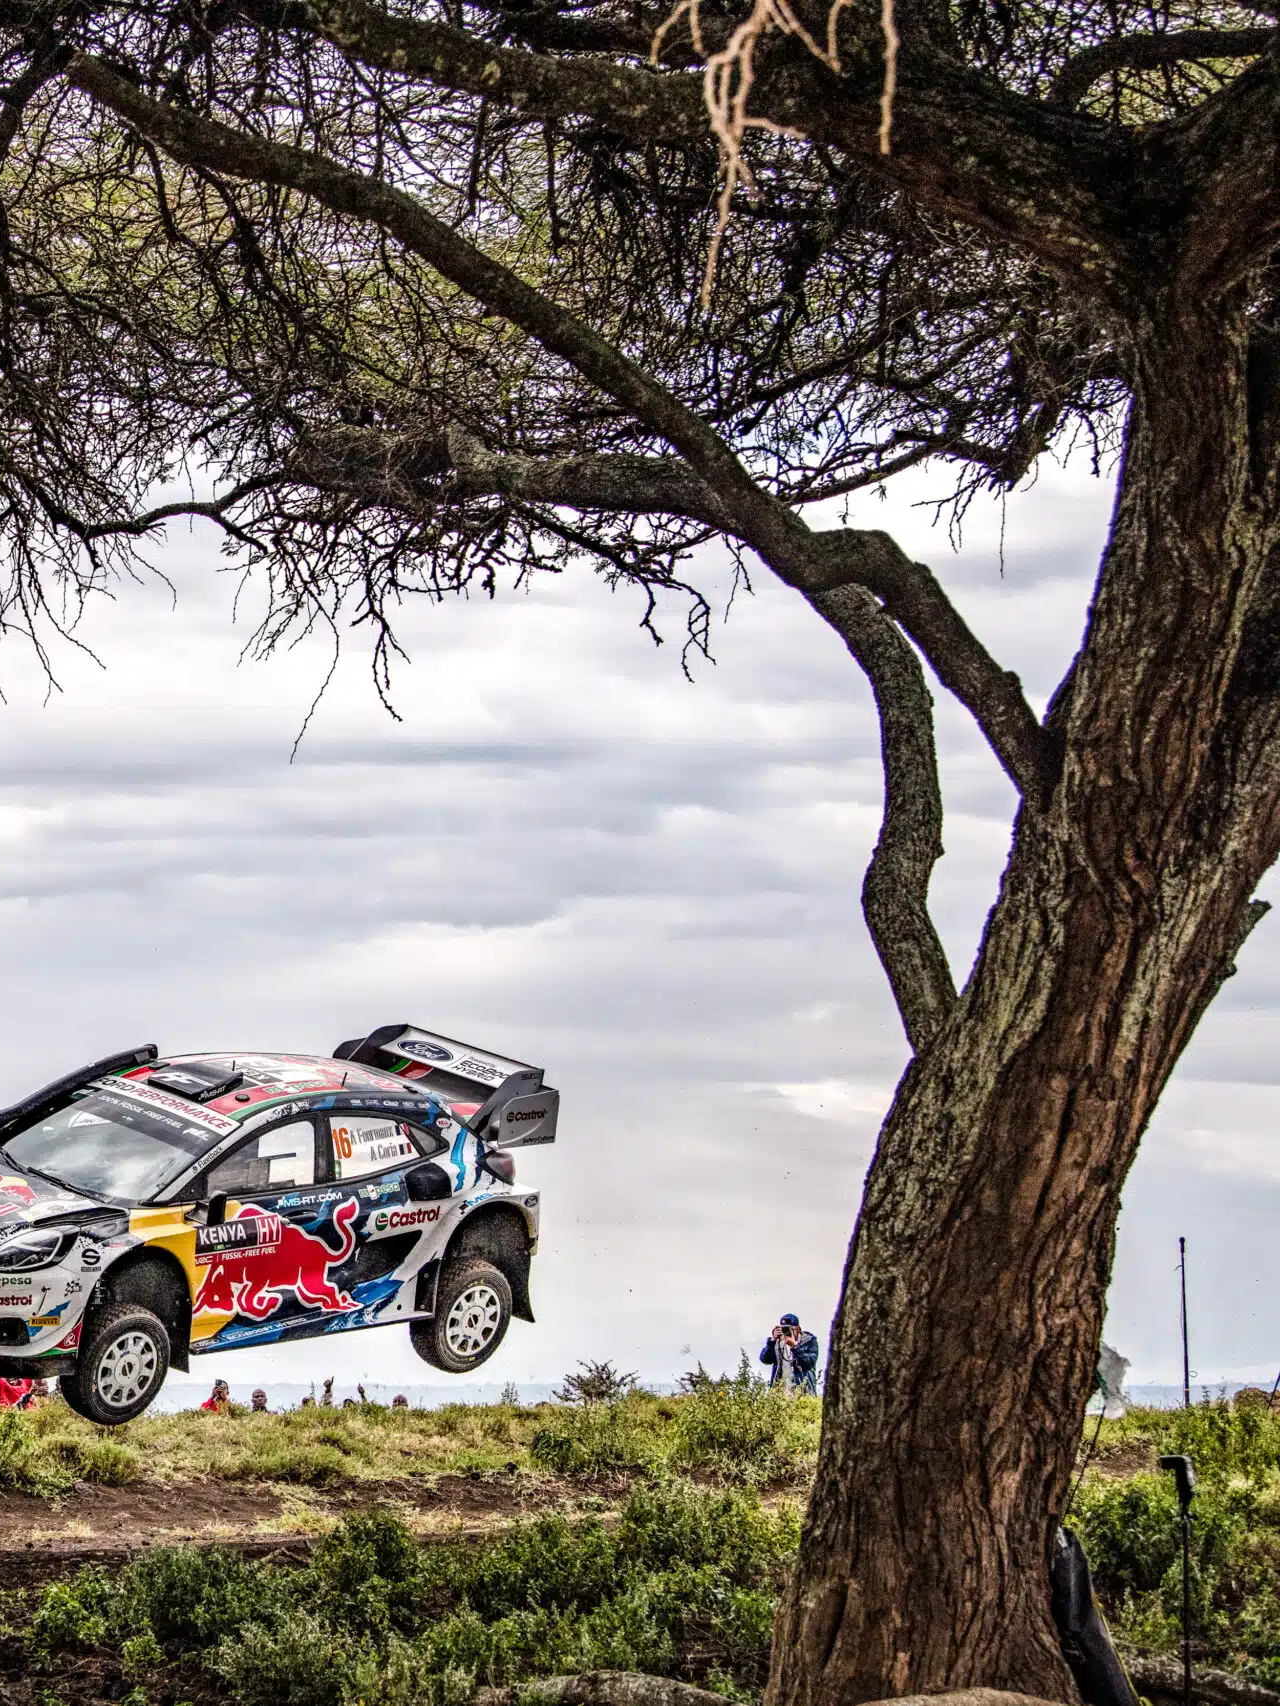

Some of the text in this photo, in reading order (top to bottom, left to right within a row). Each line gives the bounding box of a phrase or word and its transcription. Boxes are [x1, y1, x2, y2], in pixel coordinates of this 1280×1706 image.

[406, 1043, 445, 1060] Ford
[452, 1065, 495, 1081] HYBRID
[133, 1087, 233, 1129] PERFORMANCE
[515, 1109, 546, 1121] Castrol
[164, 1116, 183, 1129] FUEL
[332, 1127, 352, 1159] 16
[350, 1126, 394, 1145] A Fourmaux
[371, 1147, 378, 1161] A
[390, 1206, 441, 1228] Castrol
[200, 1224, 247, 1245] KENYA
[258, 1216, 279, 1242] HY
[222, 1248, 260, 1260] FOSSIL-FREE
[261, 1246, 276, 1254] FUEL
